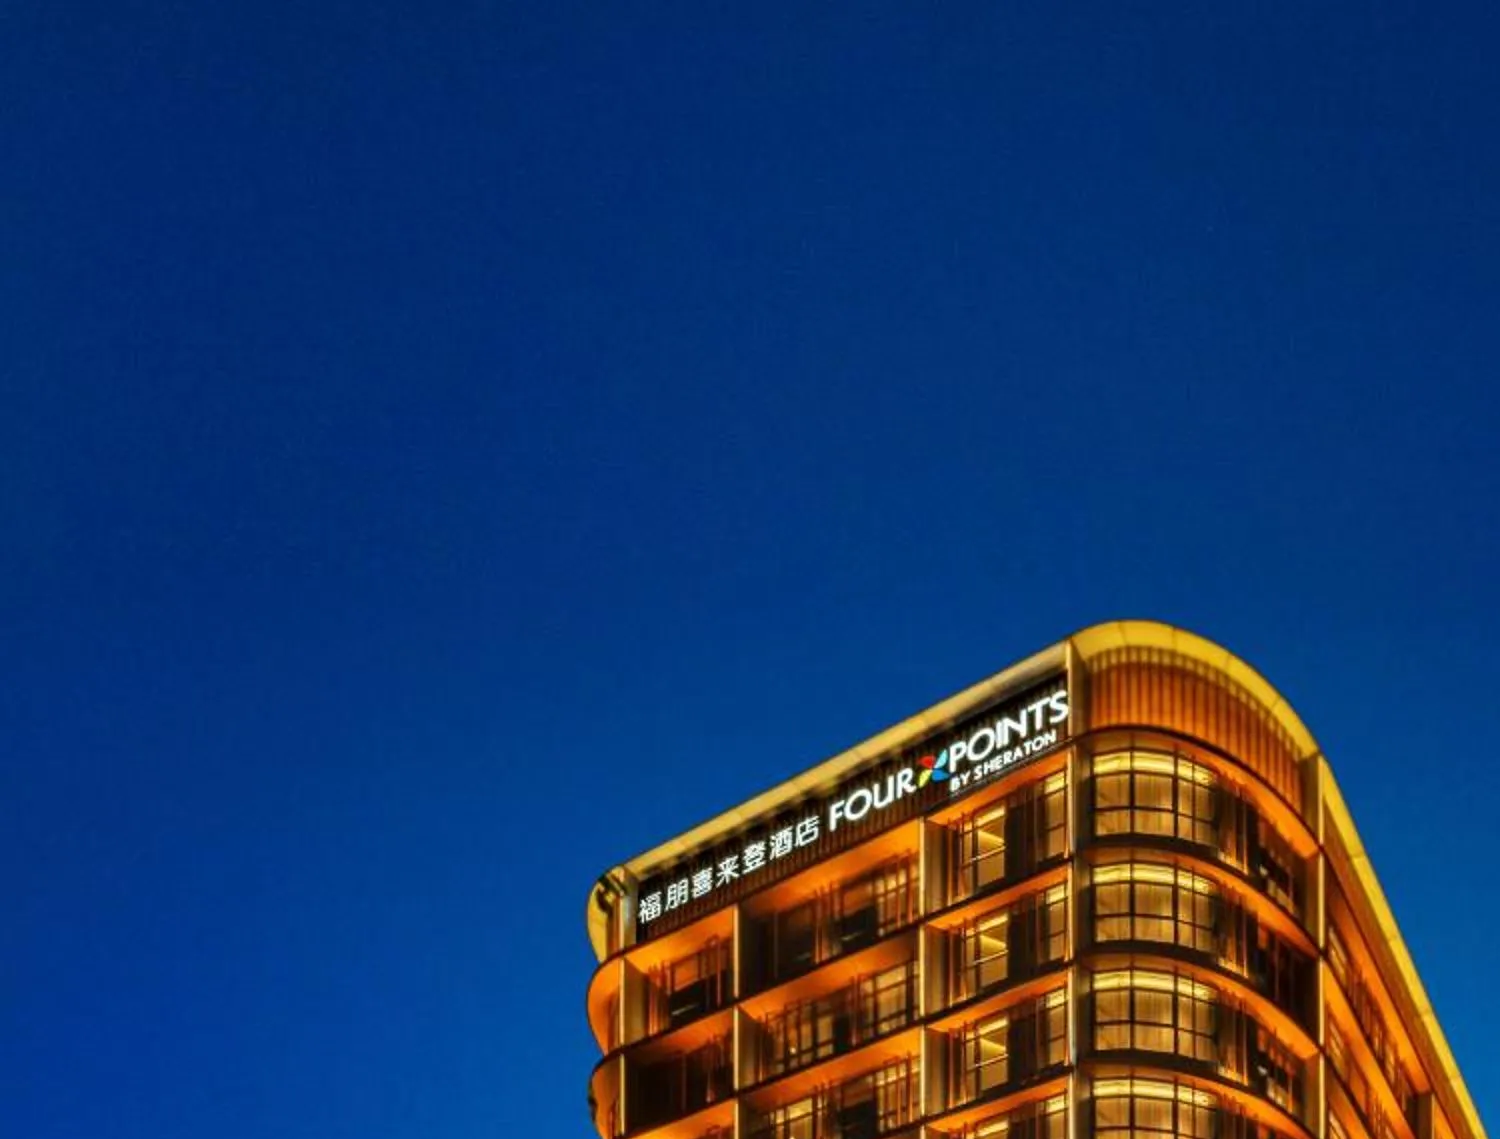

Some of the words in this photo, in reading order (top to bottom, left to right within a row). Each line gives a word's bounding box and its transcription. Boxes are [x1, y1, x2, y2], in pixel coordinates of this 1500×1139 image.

[829, 768, 917, 832] FOUR
[948, 689, 1071, 774] POINTS
[949, 771, 971, 793] BY
[974, 729, 1057, 781] SHERATON
[638, 816, 820, 924] 福朋喜来登酒店
